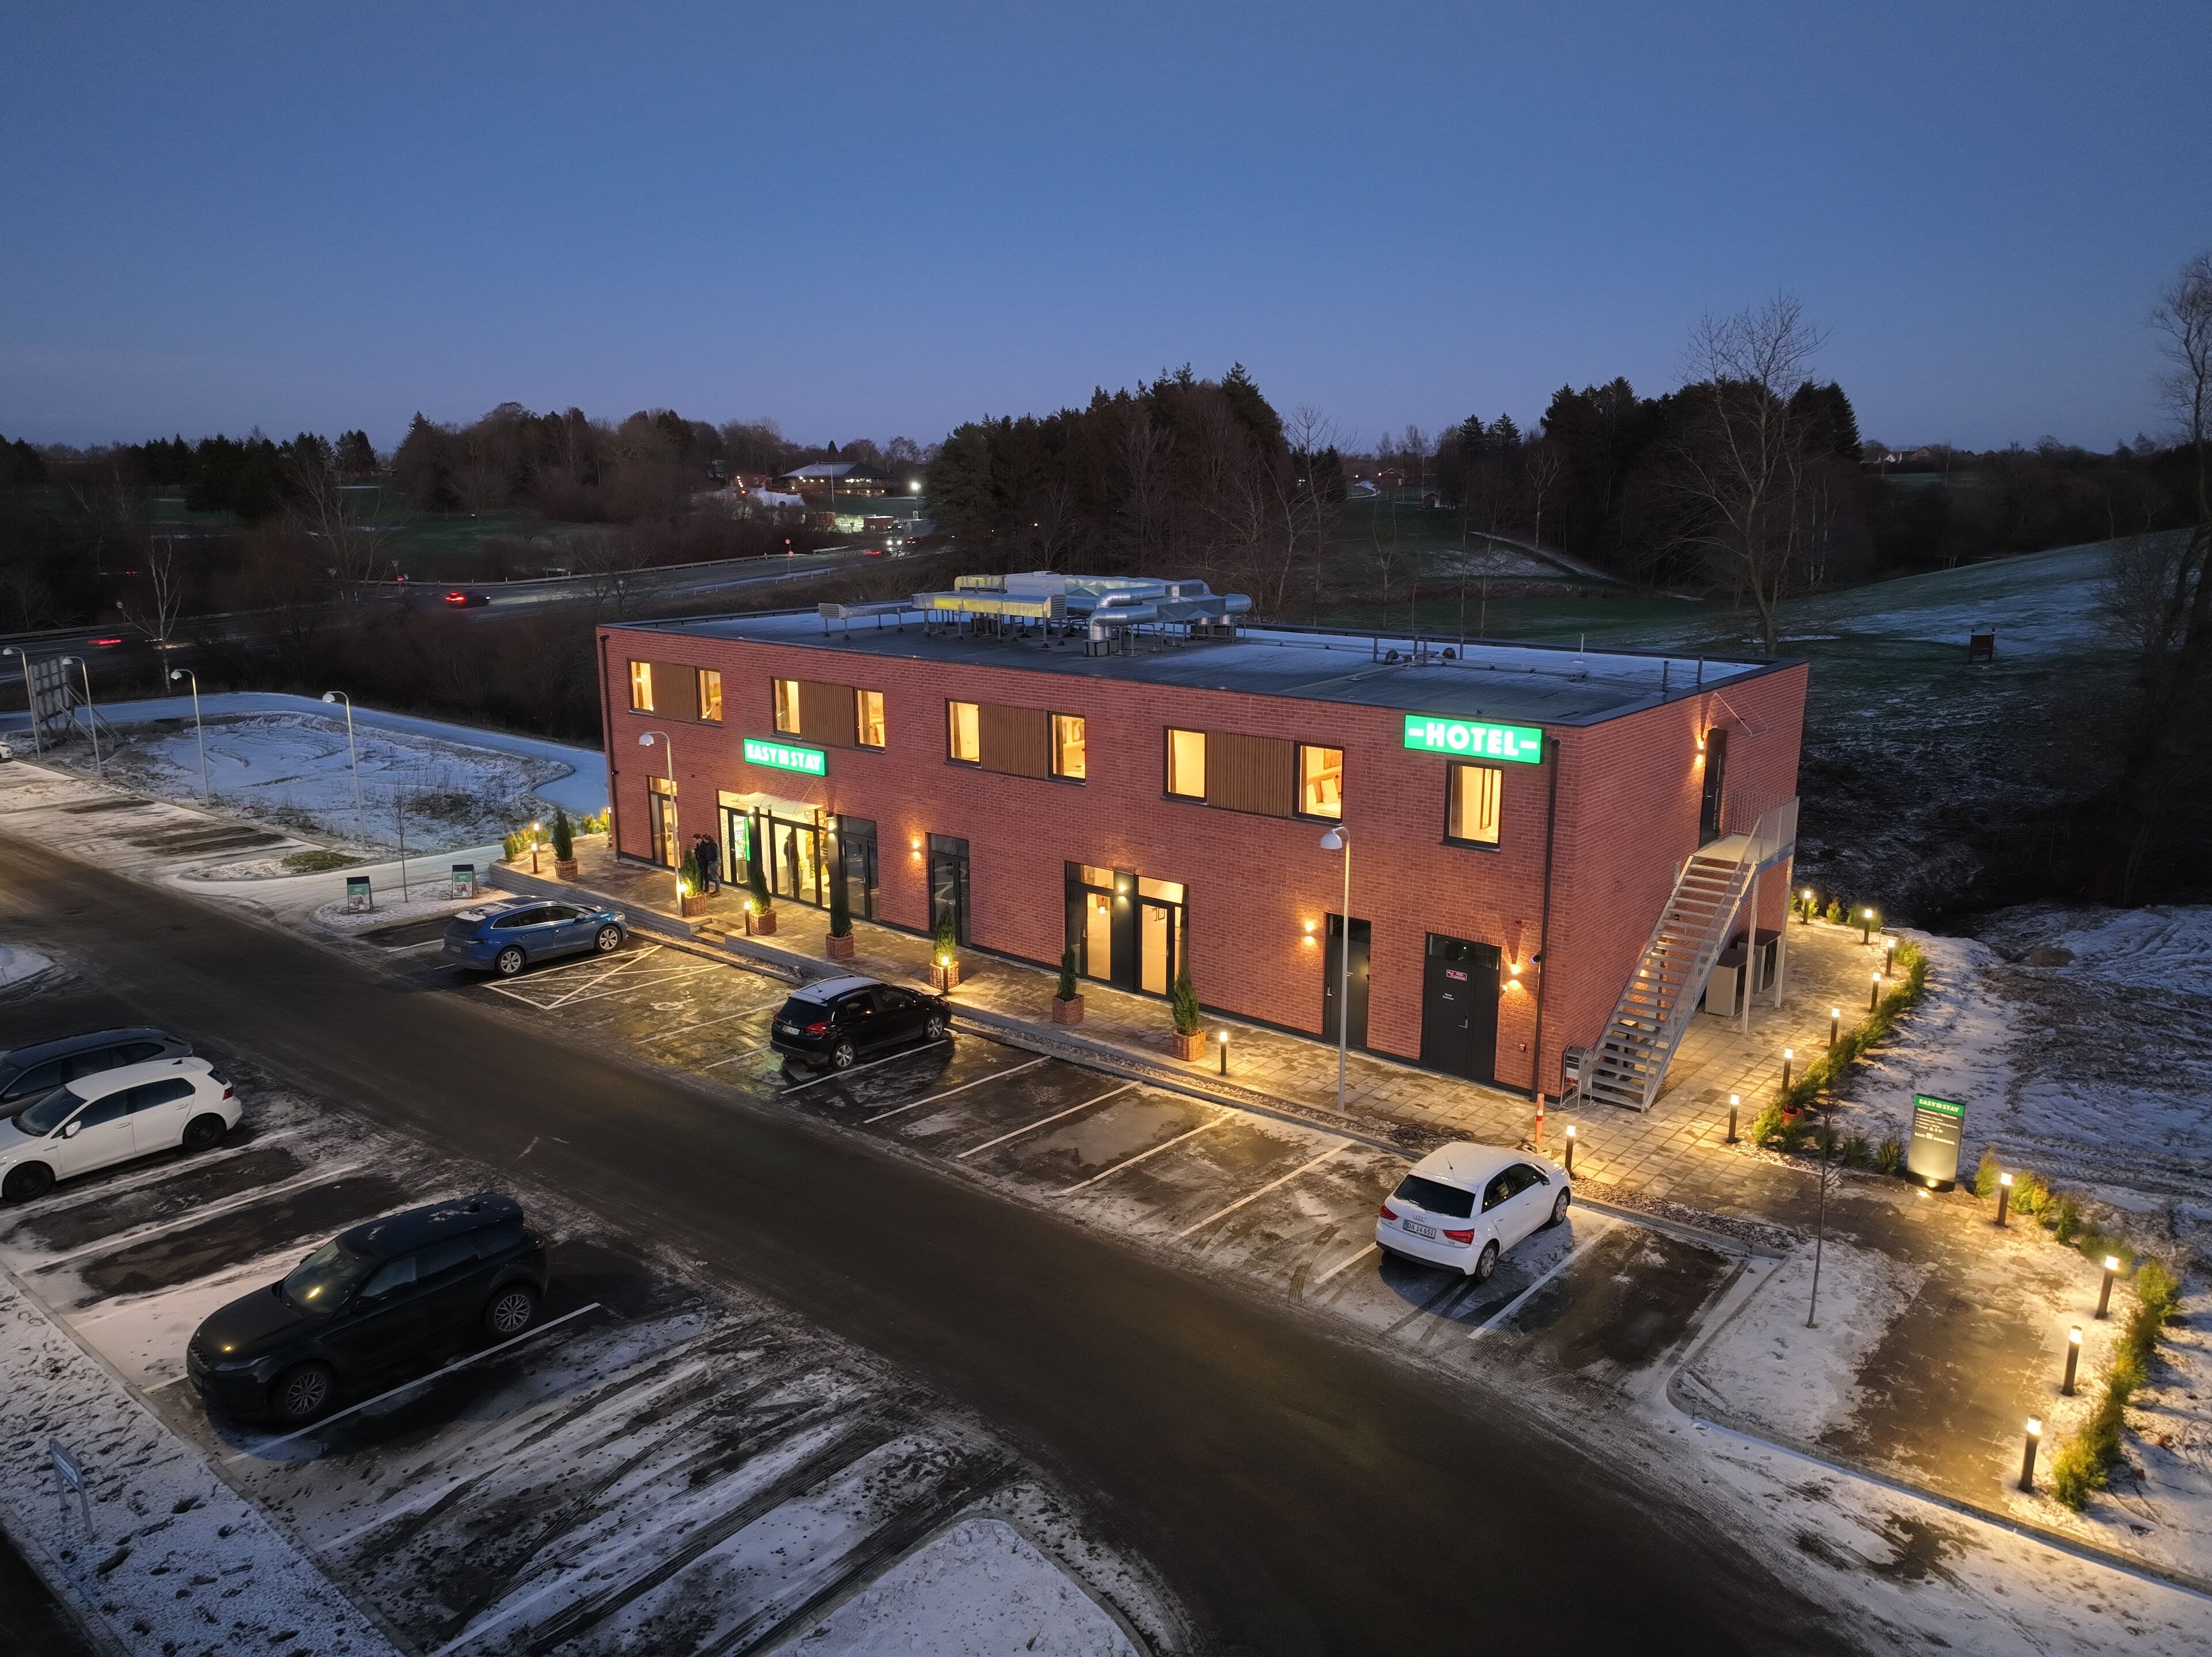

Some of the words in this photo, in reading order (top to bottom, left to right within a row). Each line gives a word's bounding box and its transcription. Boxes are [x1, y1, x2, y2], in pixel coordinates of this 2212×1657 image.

[747, 744, 777, 763] EASY
[790, 751, 821, 771] STAY
[1919, 1098, 1936, 1107] EASY
[1942, 1104, 1960, 1113] STAY
[1423, 1227, 1433, 1236] 651
